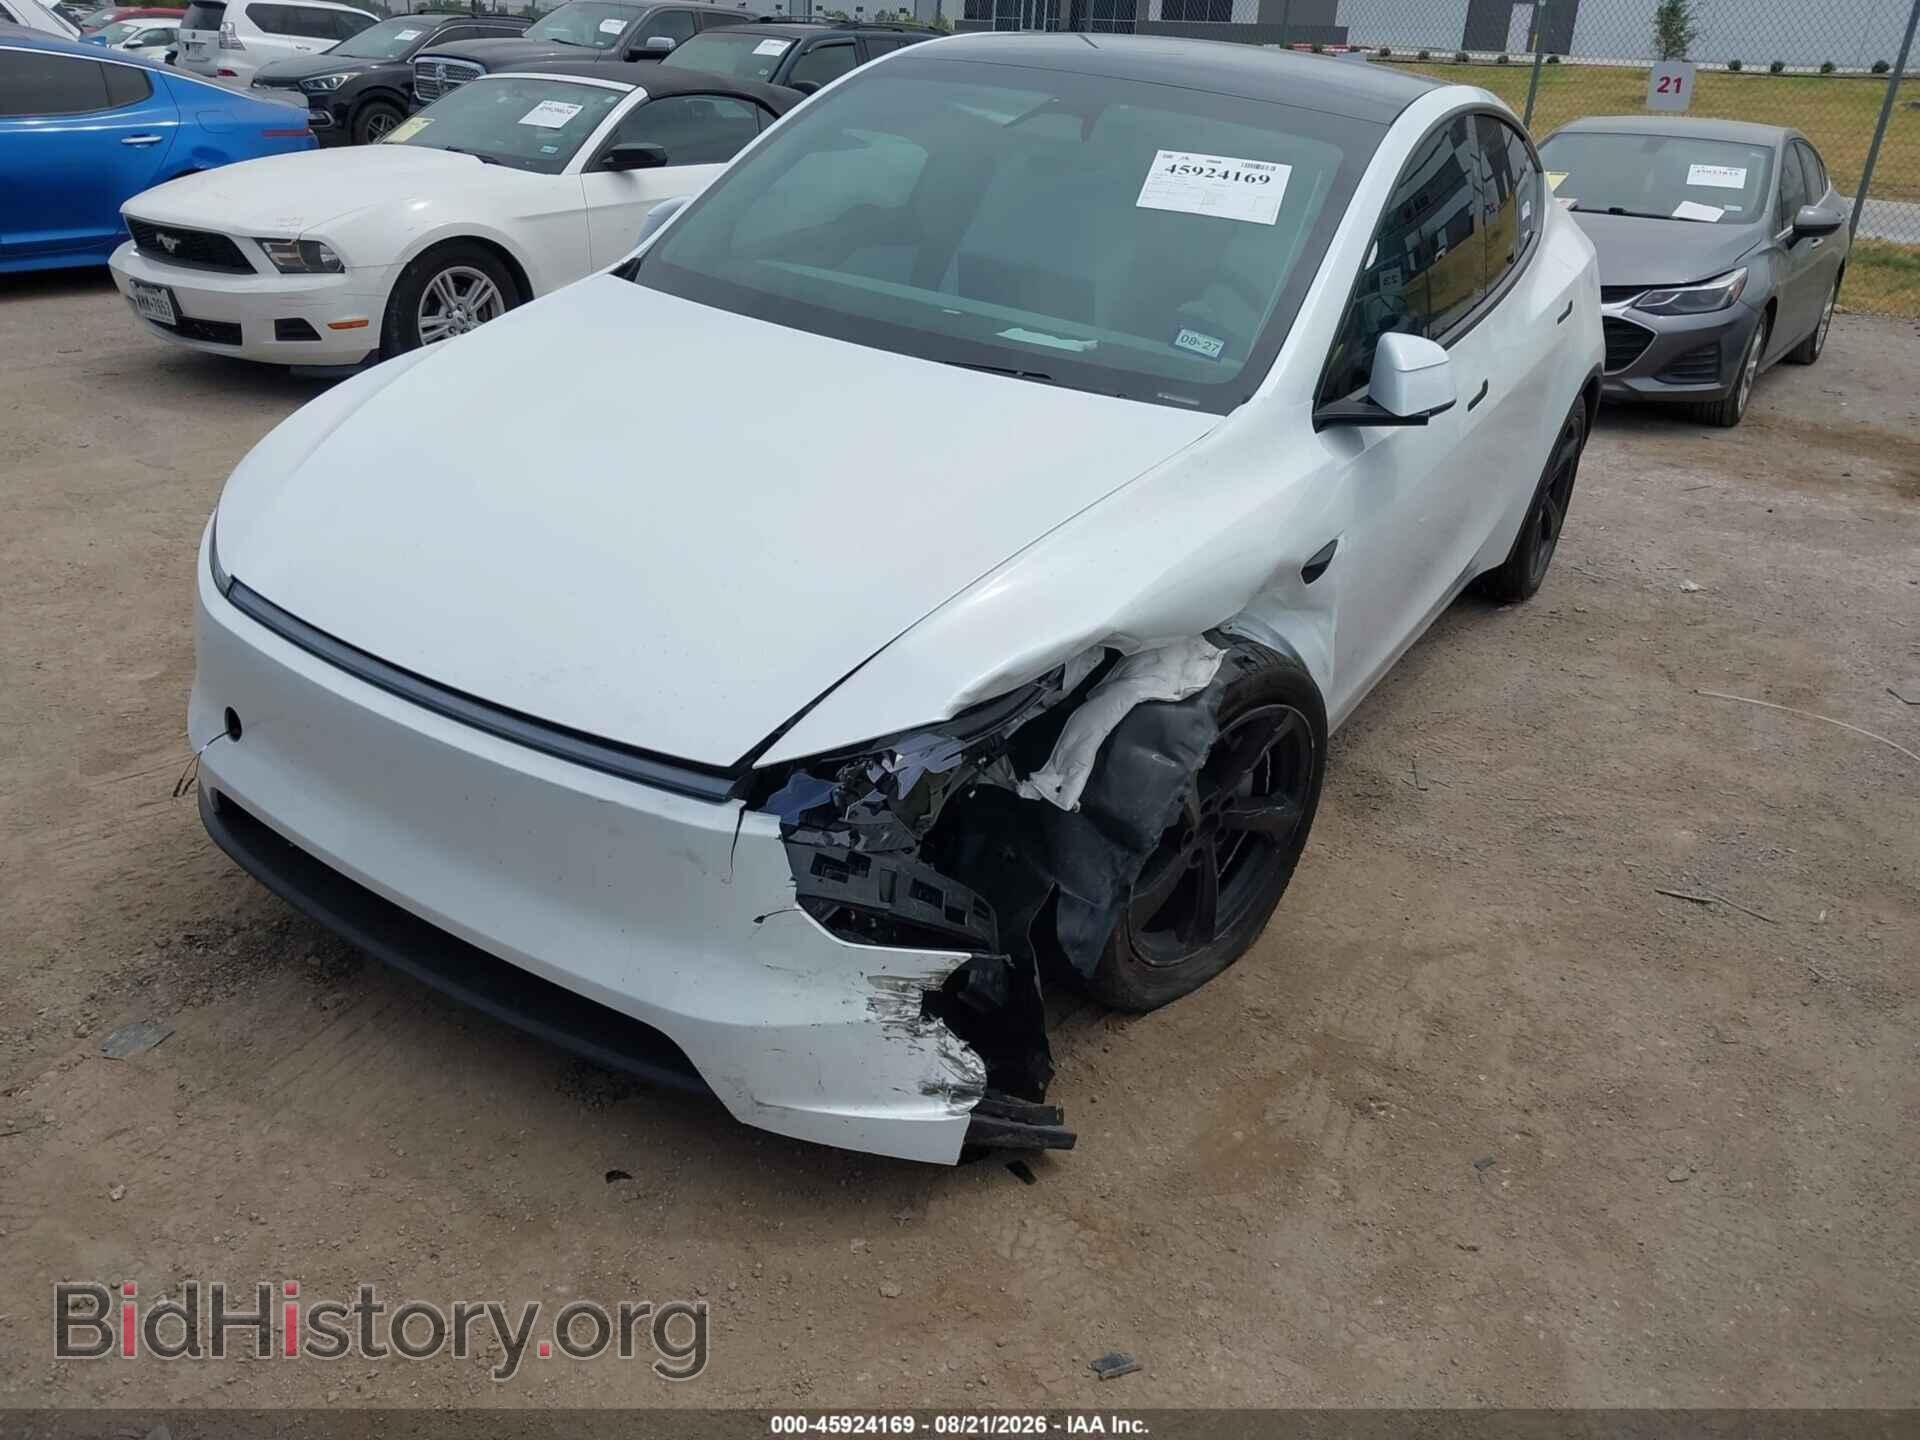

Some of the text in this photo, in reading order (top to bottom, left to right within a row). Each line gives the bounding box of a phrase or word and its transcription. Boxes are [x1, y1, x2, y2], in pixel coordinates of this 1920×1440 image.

[1656, 76, 1682, 94] 21
[1165, 164, 1271, 184] 45924169
[1181, 335, 1220, 352] 08-27
